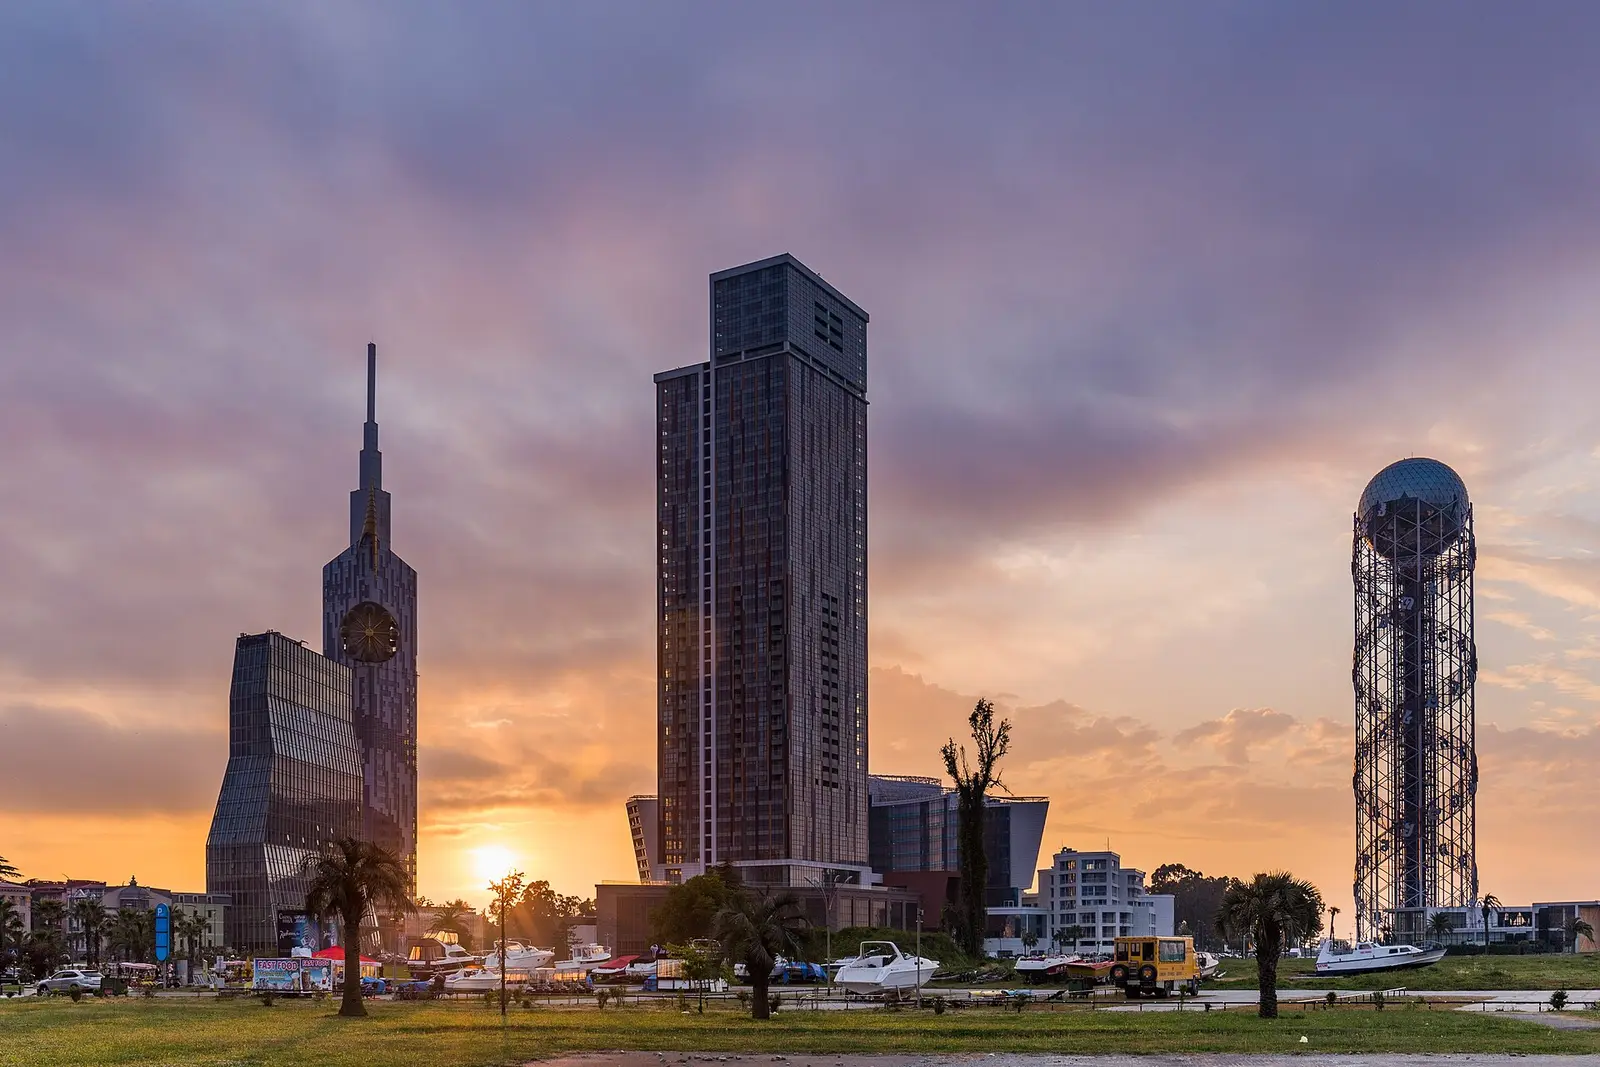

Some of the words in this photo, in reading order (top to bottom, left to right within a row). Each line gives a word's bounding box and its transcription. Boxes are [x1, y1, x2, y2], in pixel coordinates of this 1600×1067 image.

[157, 908, 163, 916] P
[258, 961, 276, 970] FAST
[278, 961, 298, 970] FOOD
